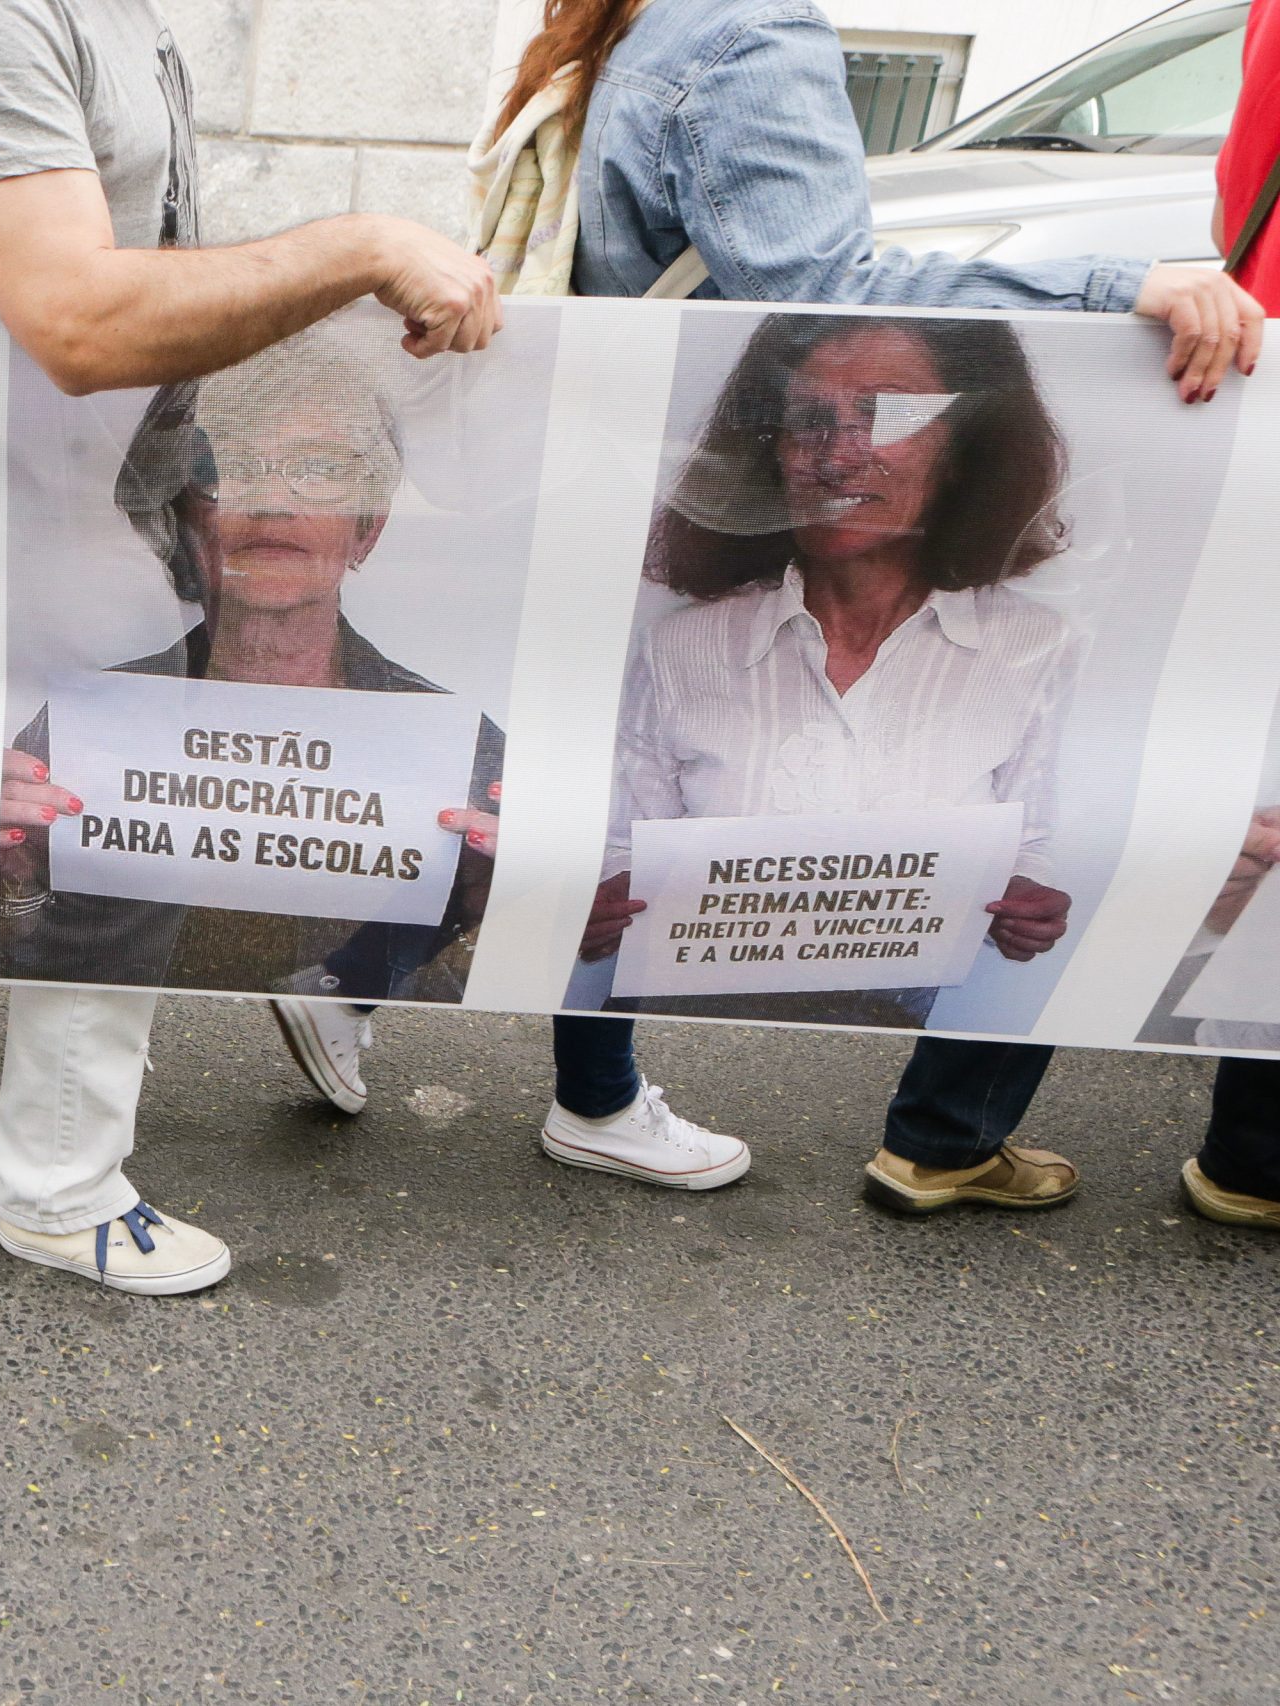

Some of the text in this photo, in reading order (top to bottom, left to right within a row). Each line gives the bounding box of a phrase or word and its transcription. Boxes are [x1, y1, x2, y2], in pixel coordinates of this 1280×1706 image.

[183, 728, 332, 771] GESTÃO
[123, 768, 384, 827] DEMOCRÁTICA
[80, 814, 423, 881] PARA AS ESCOLAS
[707, 851, 940, 885] NECESSIDADE
[698, 887, 931, 915] PERMANENTE:
[668, 916, 944, 940] DIREITO A VINCULAR
[675, 940, 920, 963] E A UMA CARREIRA
